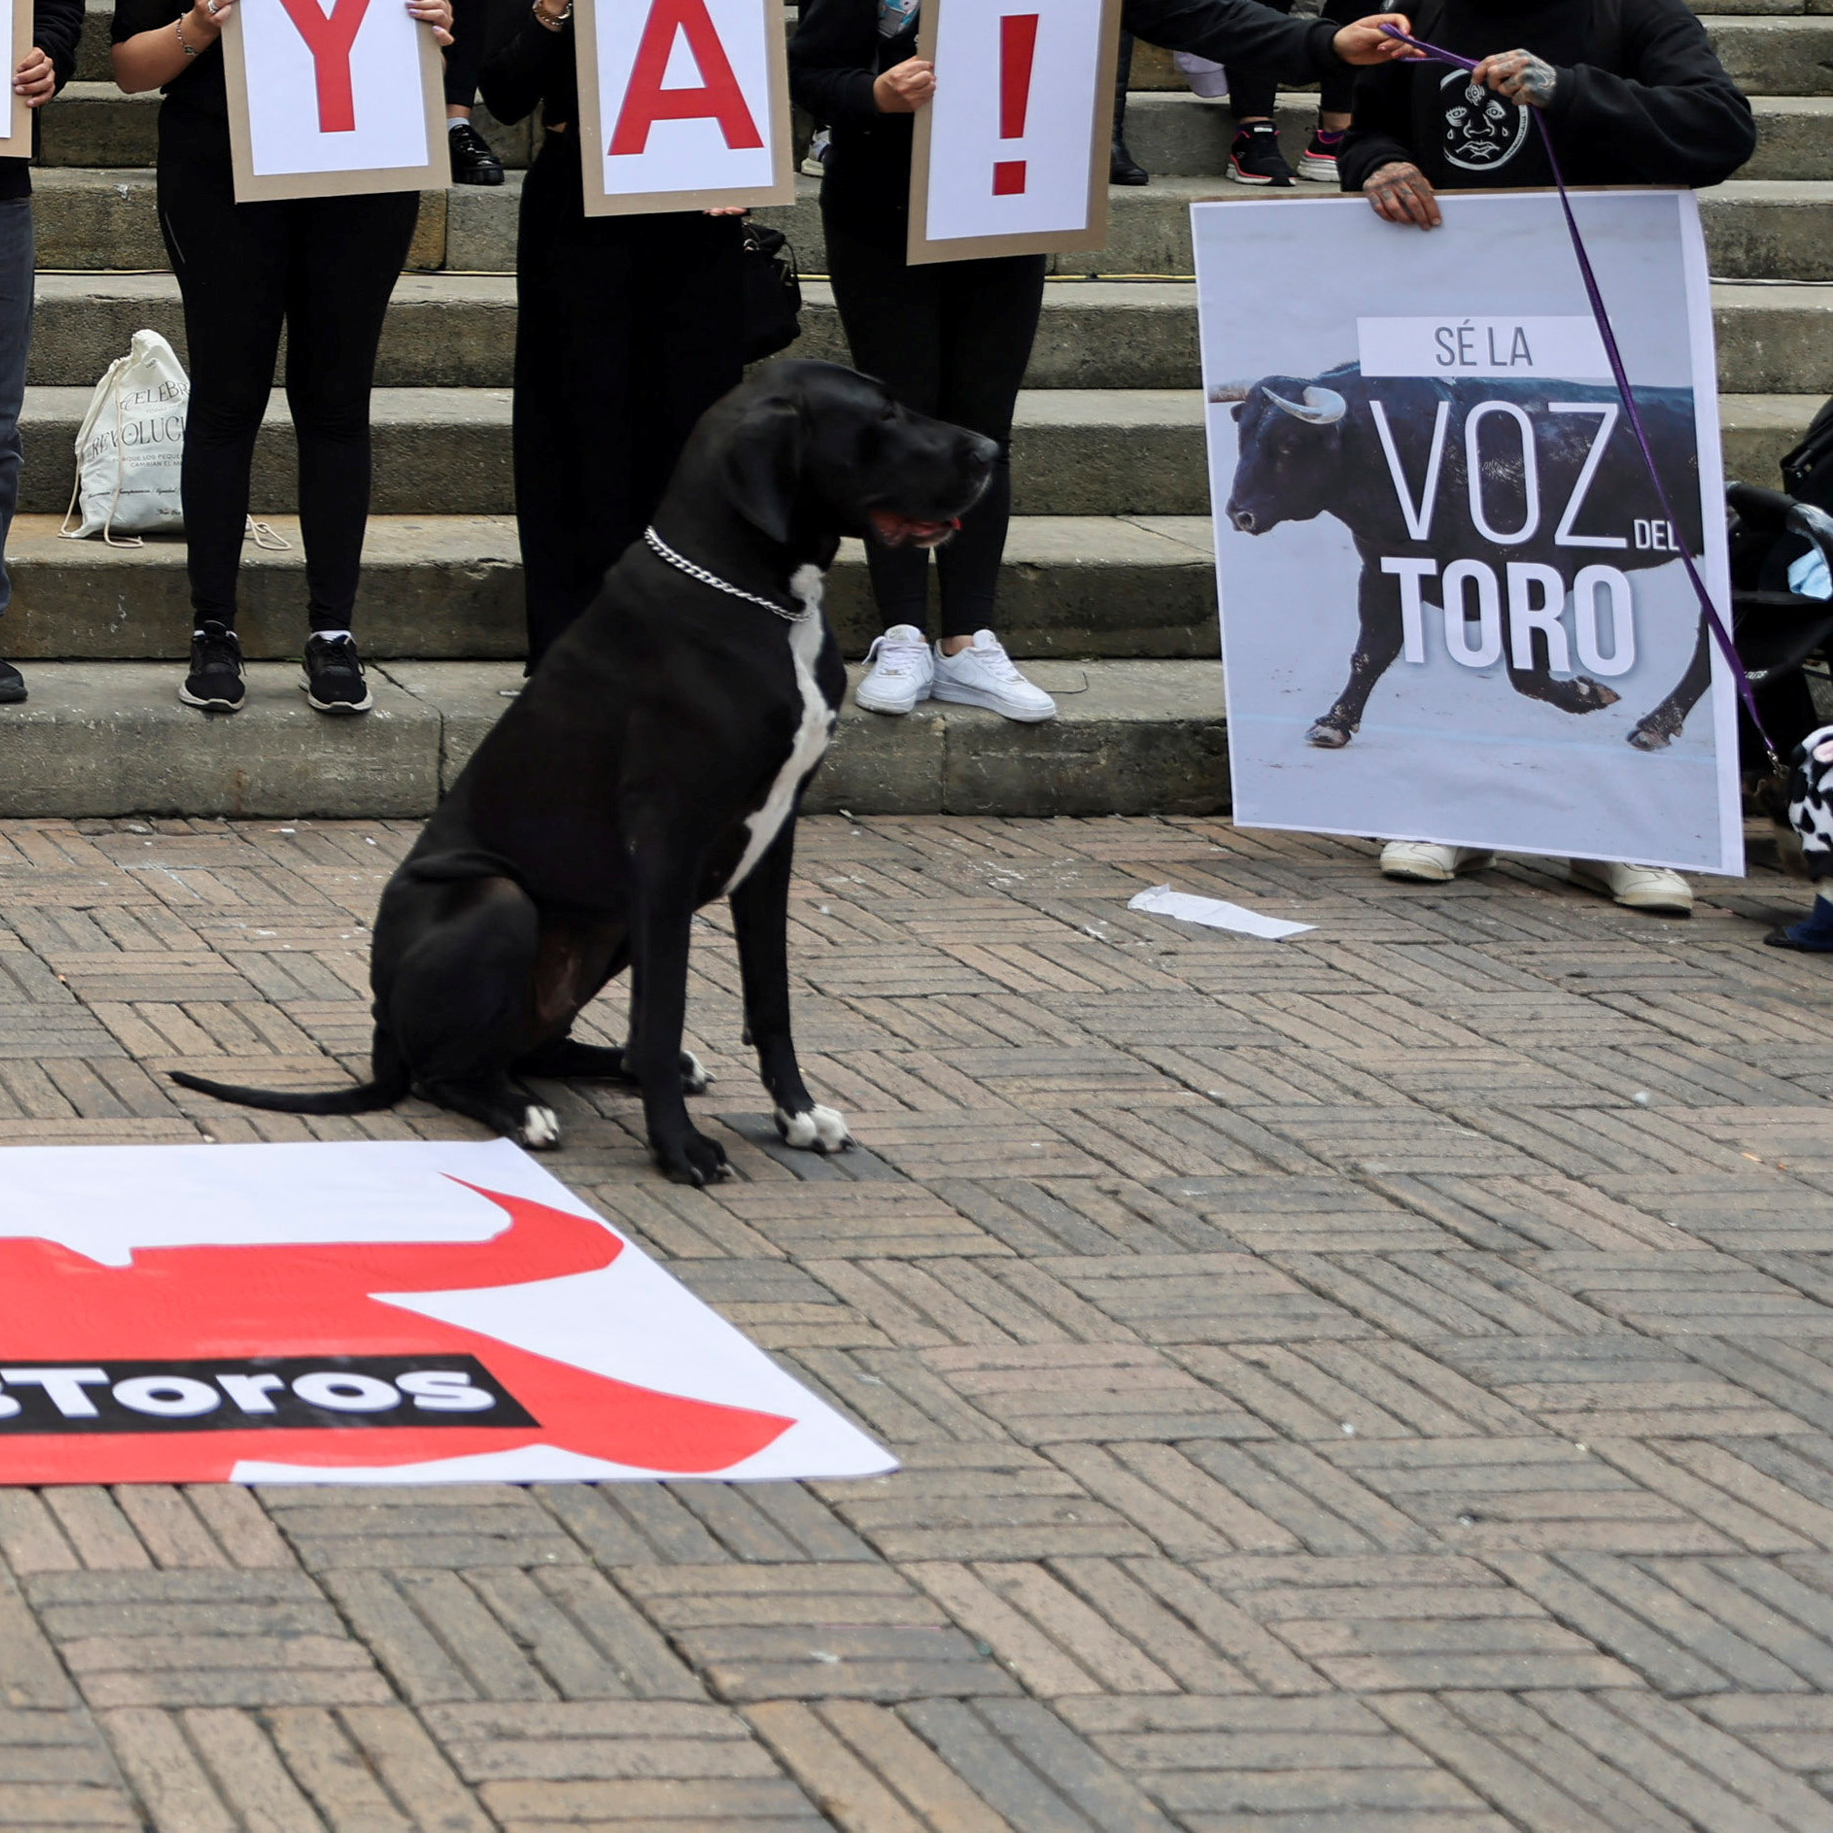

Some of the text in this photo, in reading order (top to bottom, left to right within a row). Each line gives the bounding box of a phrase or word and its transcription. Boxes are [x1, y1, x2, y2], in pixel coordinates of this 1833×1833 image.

[1434, 318, 1533, 367] SÉ LA
[1369, 399, 1681, 551] VOZ DEL
[1380, 556, 1636, 677] TORO
